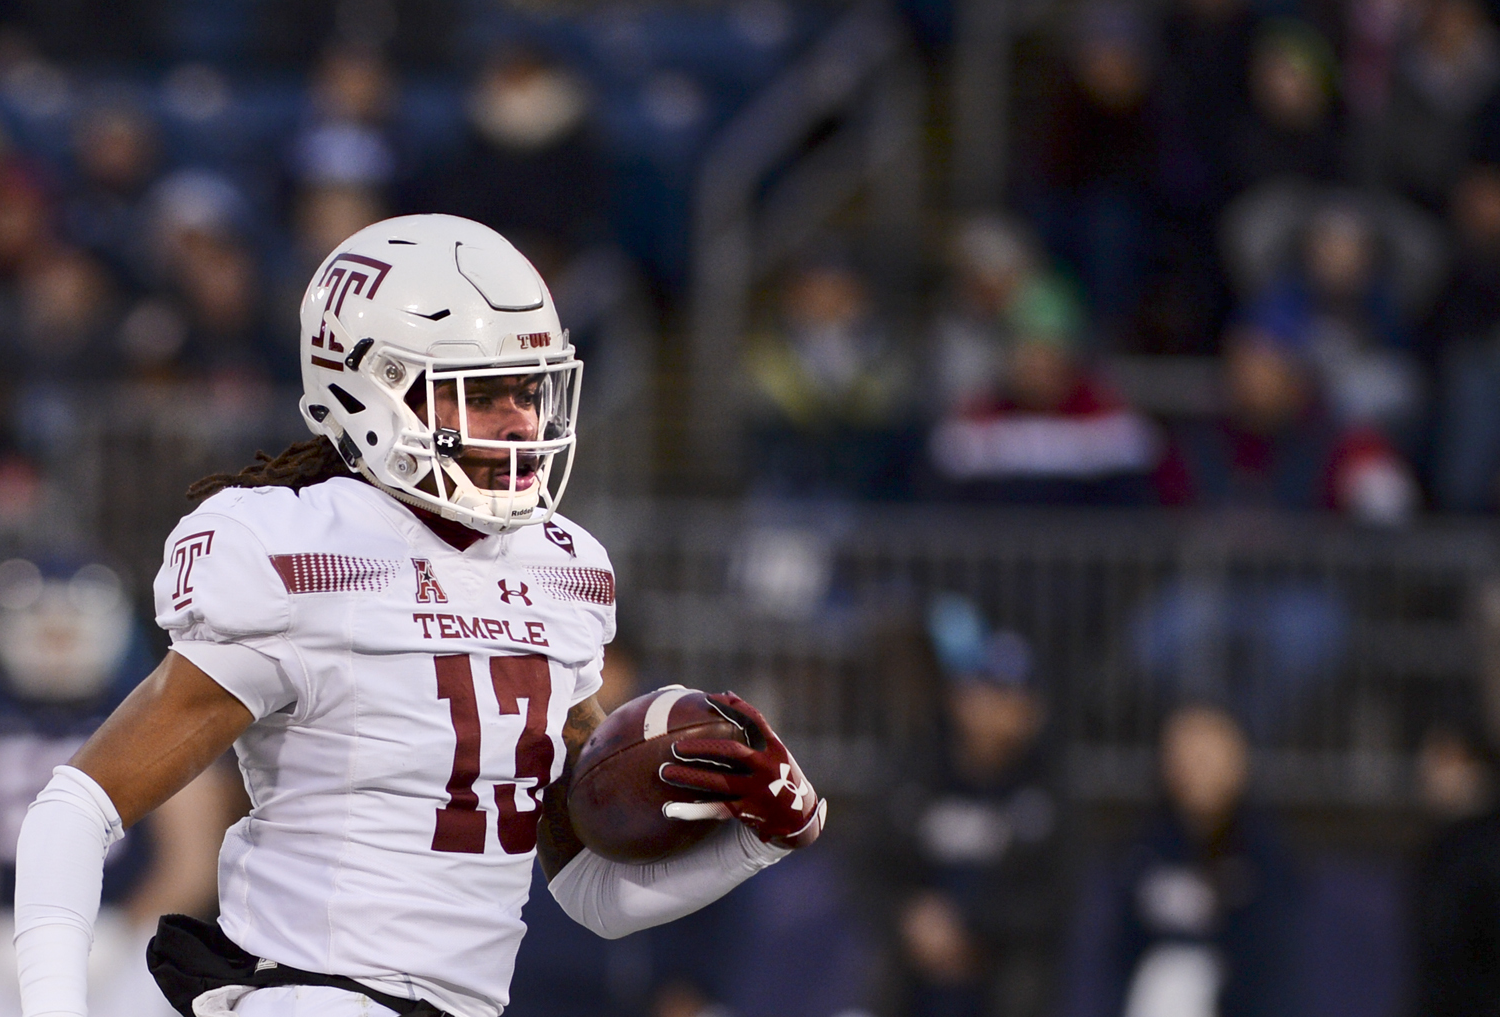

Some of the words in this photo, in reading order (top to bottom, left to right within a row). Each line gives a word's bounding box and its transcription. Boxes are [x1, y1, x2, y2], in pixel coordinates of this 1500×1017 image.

[311, 253, 393, 373] T
[517, 331, 552, 350] TUFF
[546, 526, 572, 545] C
[169, 529, 215, 612] T
[410, 557, 449, 604] A
[412, 612, 550, 648] TEMPLE
[430, 653, 553, 855] 13
